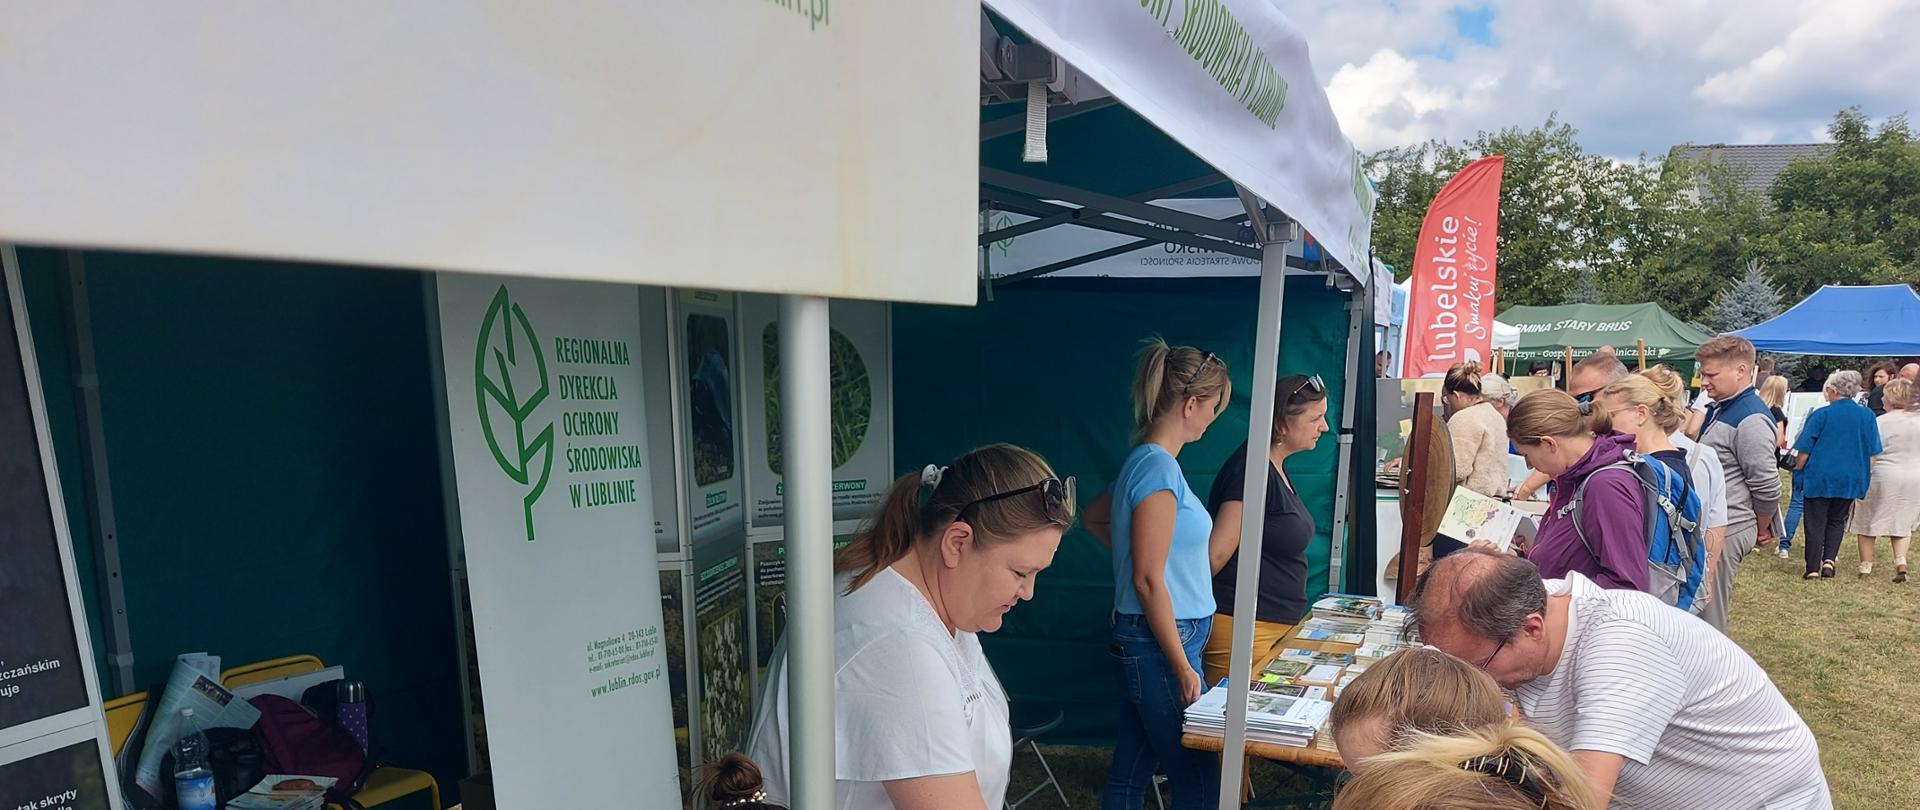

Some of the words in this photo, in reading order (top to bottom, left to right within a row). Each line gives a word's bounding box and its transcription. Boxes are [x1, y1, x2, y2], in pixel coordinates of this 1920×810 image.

[1238, 47, 1263, 104] W
[1428, 216, 1459, 361] lubelskie
[1463, 272, 1494, 340] Smakuj
[1553, 319, 1597, 331] STARY
[1596, 320, 1633, 332] BRUS
[555, 337, 630, 366] REGIONALNA
[559, 375, 618, 400] DYREKCJA
[563, 411, 619, 436] OCHRONY
[566, 442, 642, 473] ŚRODOWISKA
[569, 483, 581, 508] W
[585, 479, 636, 507] LUBLINIE
[0, 659, 61, 680] czańskim
[591, 664, 661, 697] www.lublin.rdos.gov.pl
[0, 684, 20, 697] uje
[40, 789, 77, 808] skryty
